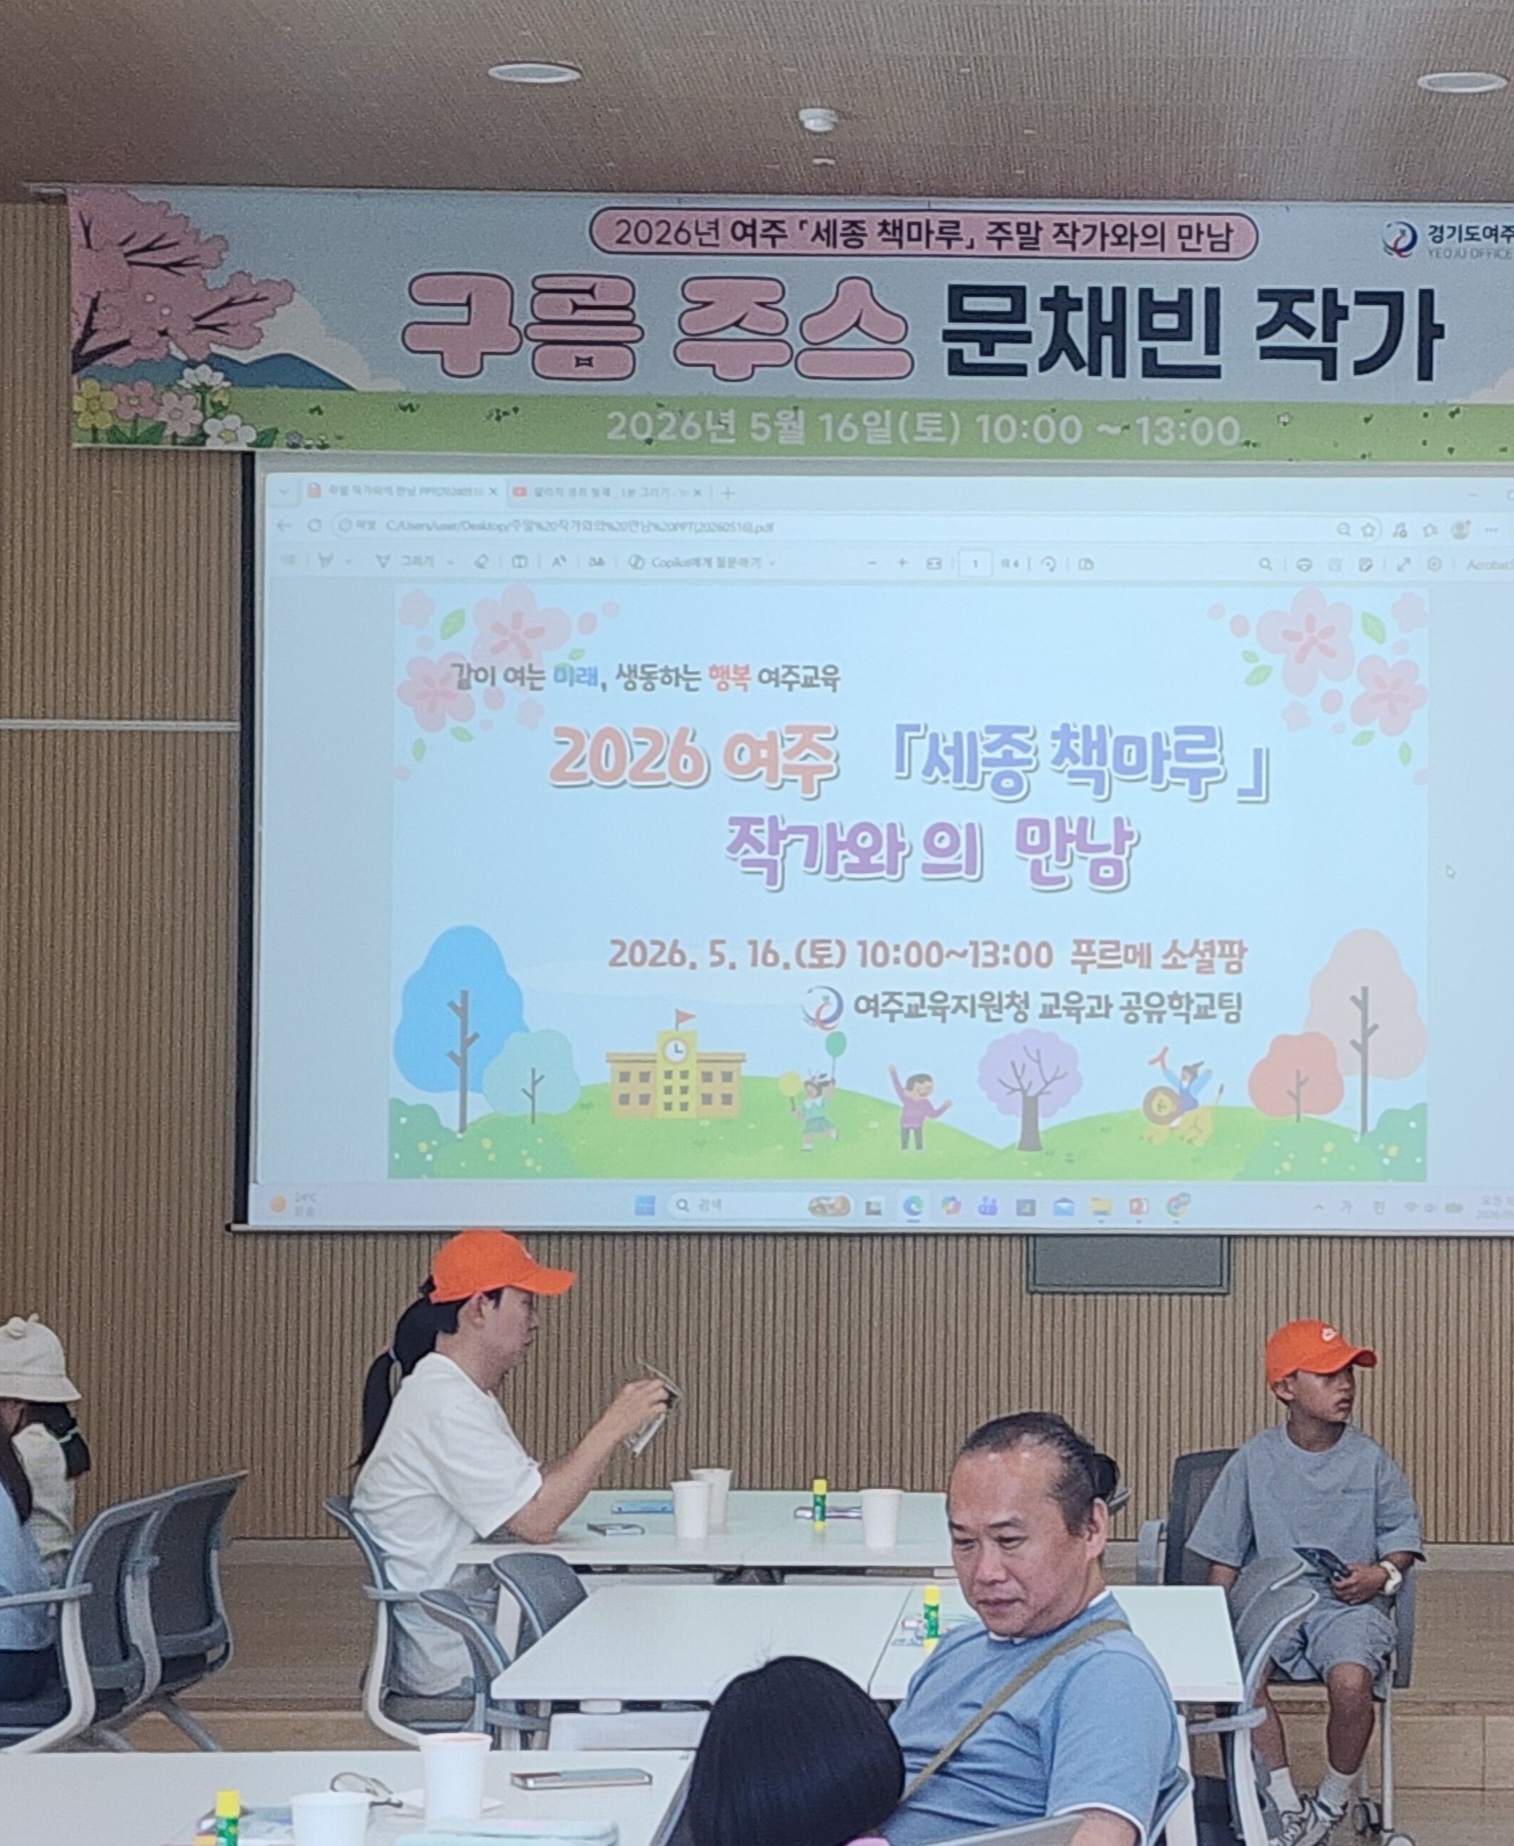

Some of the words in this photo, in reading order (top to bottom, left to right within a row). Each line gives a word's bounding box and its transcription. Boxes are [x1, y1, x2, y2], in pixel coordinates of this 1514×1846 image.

[615, 218, 720, 248] 2026년
[730, 218, 788, 249] 여주
[877, 218, 975, 250] 책마루」
[986, 220, 1043, 251] 주말
[1052, 220, 1166, 252] 작가와의
[1177, 221, 1234, 253] 만남
[1471, 248, 1513, 260] OFFICE
[402, 271, 645, 382] 구름
[673, 275, 915, 384] 주스
[941, 281, 1225, 381] 문채빈
[1254, 285, 1446, 383] 작가
[606, 408, 737, 444] 2026년
[750, 409, 806, 445] 5월
[818, 409, 961, 447] 16일(토)
[976, 413, 1083, 445] 10:00
[450, 663, 497, 694] 같이
[503, 663, 547, 693] 여는
[615, 662, 702, 693] 생동하는
[708, 663, 752, 693] 행복
[757, 664, 842, 694] 여주교육
[550, 724, 709, 788] 2026
[722, 722, 838, 798] 여주
[1015, 814, 1139, 892] 만남
[857, 939, 1054, 971] 10:00~13:00
[1071, 938, 1152, 975] 푸르메
[853, 989, 1031, 1023] 여주교육지원청
[1038, 989, 1114, 1024] 교육과
[1119, 991, 1243, 1025] 공유학교팀
